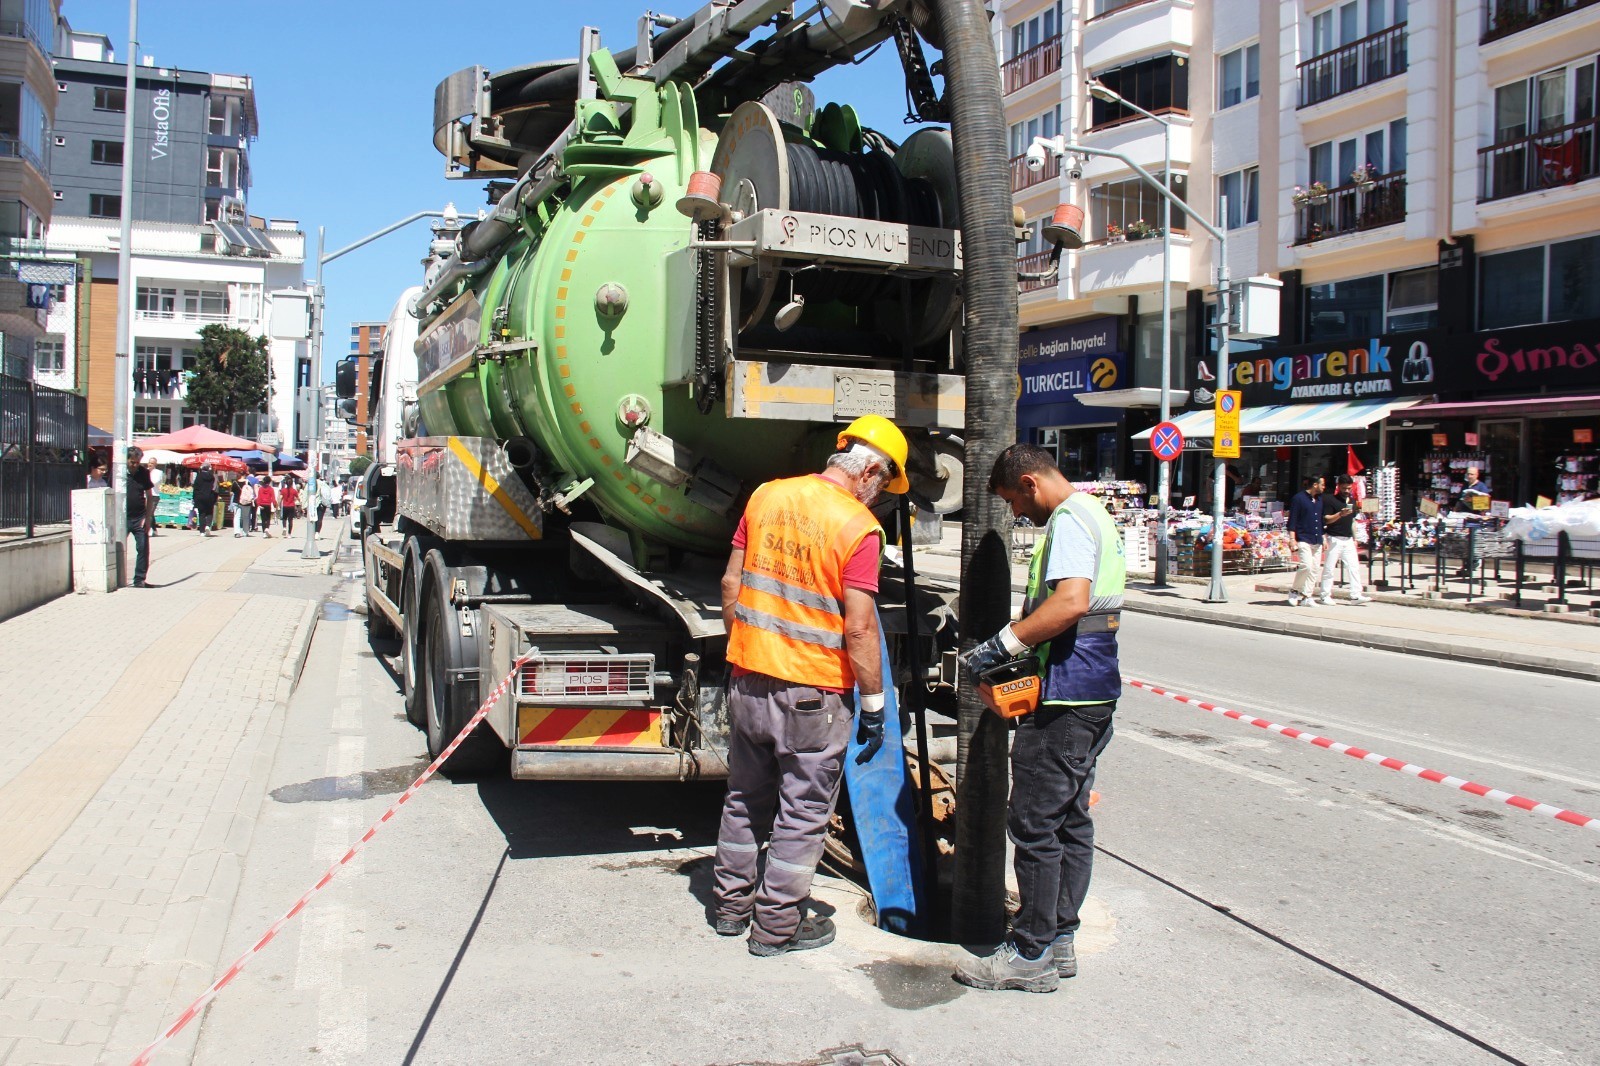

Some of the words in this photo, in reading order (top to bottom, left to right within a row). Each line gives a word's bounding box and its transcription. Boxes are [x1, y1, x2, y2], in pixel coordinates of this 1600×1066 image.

[151, 88, 170, 161] VistaOfis
[863, 231, 963, 259] MÜHENDİS
[1039, 341, 1069, 357] bağlan
[1070, 332, 1106, 352] hayata!
[1228, 338, 1391, 390] rengarenk
[1477, 338, 1600, 381] Şıma
[1025, 371, 1083, 394] TURKCELL
[1290, 386, 1342, 398] AYAKKABI
[1343, 385, 1351, 395] &
[1353, 379, 1392, 397] ÇANTA
[1257, 430, 1320, 445] rengarenk
[763, 532, 811, 562] SASKİ
